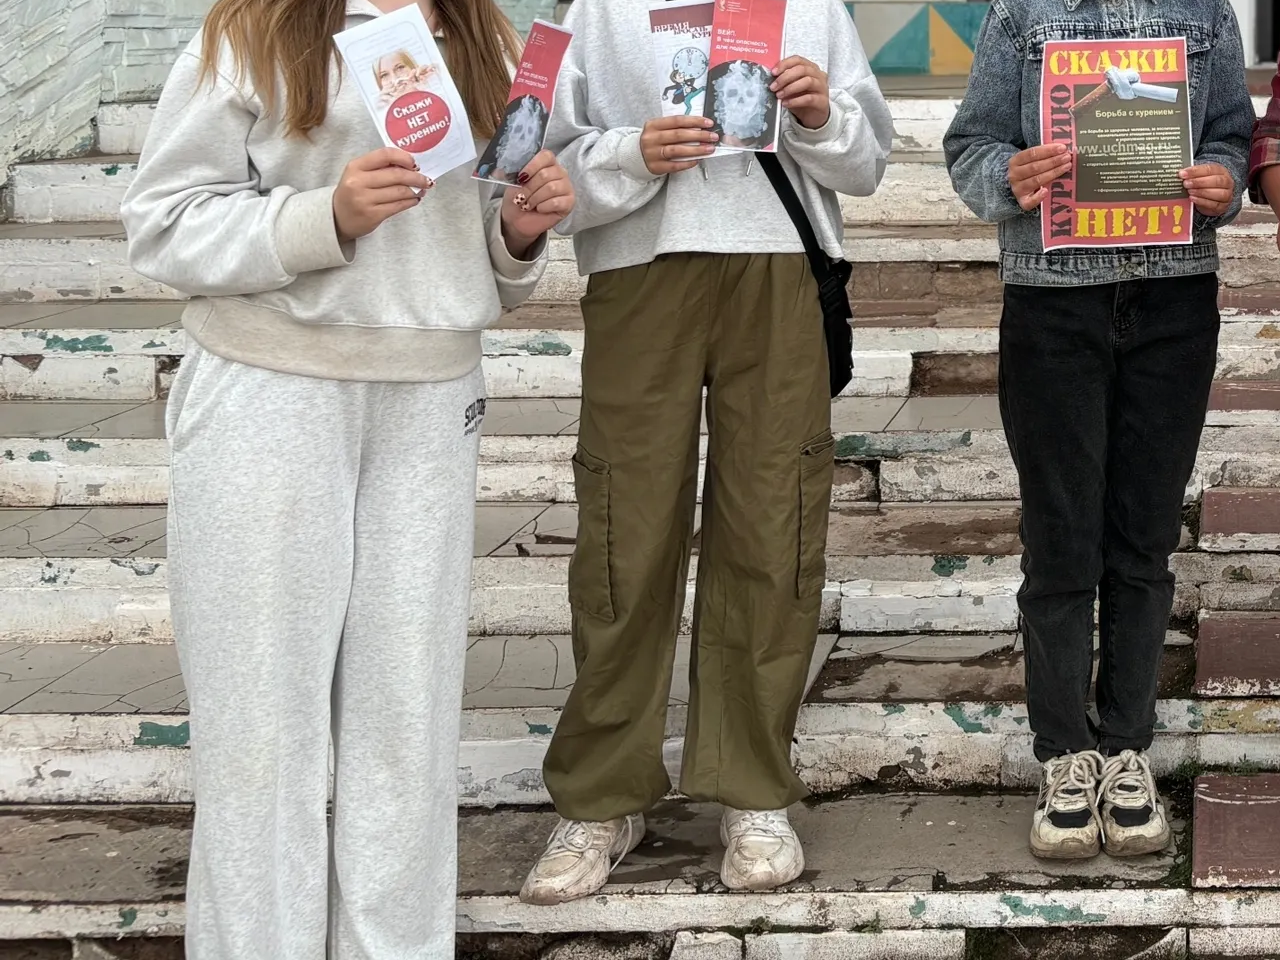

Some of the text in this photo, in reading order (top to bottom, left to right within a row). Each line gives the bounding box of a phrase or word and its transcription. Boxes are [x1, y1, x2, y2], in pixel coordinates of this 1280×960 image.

[1049, 48, 1179, 76] СКАЖИ
[393, 97, 433, 119] Скажи
[406, 111, 430, 129] НЕТ
[1095, 109, 1127, 119] Борьба
[1135, 109, 1174, 118] курением
[397, 115, 450, 147] курению!
[1051, 84, 1073, 239] КУРИЮ
[1074, 205, 1183, 238] НЕТ!
